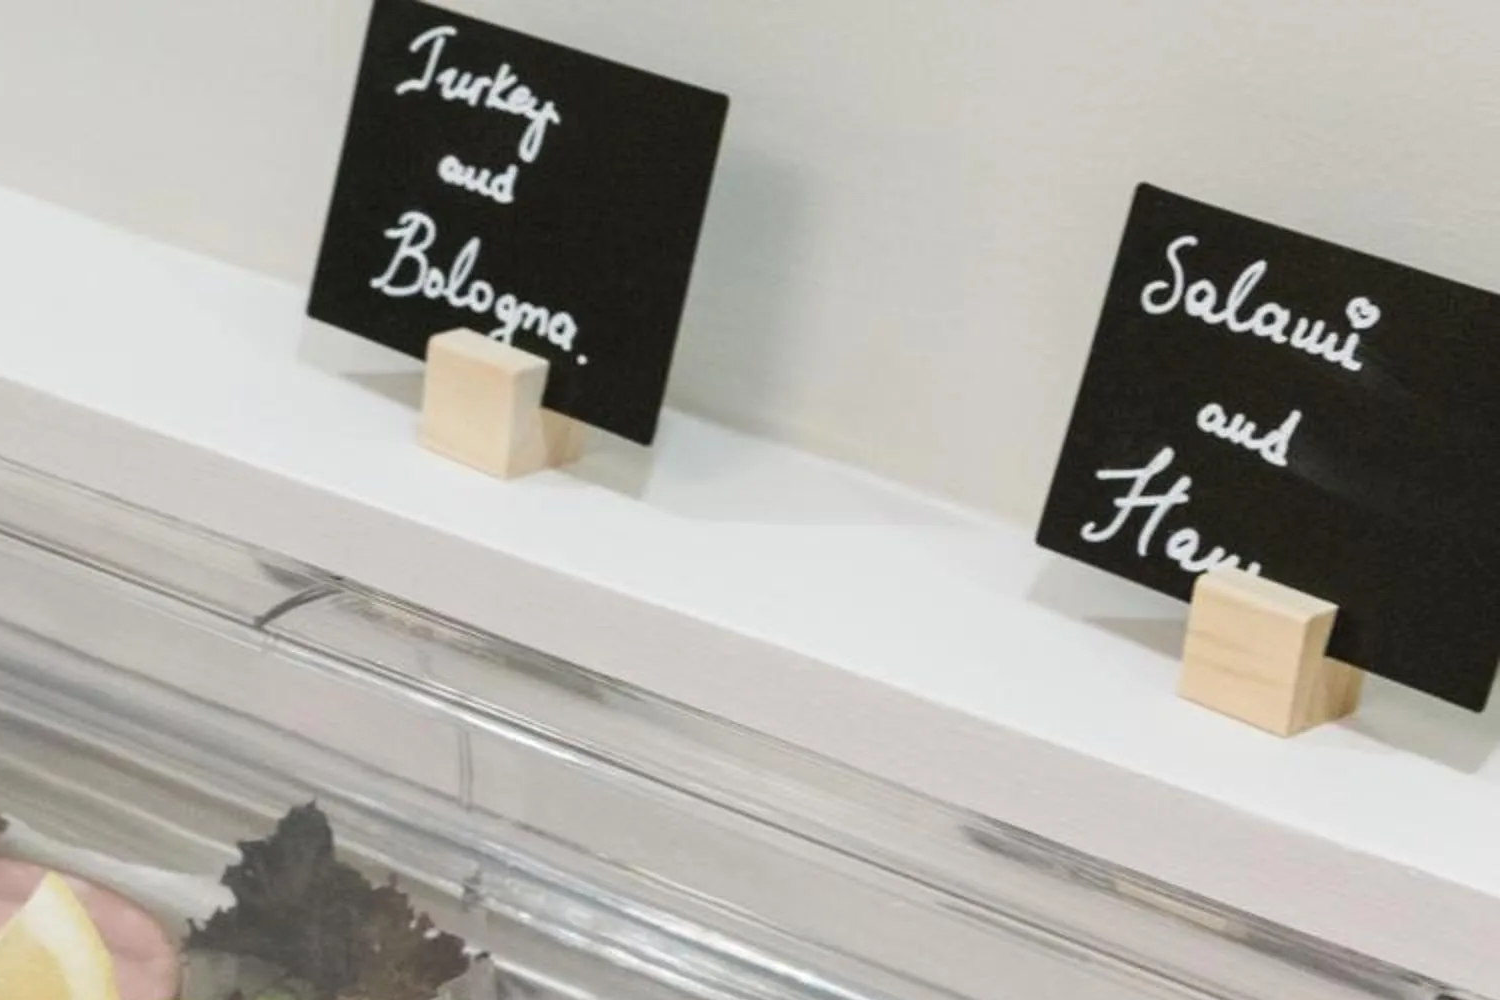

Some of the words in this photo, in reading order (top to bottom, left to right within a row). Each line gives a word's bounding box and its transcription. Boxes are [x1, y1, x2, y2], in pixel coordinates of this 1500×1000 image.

[394, 25, 561, 163] Turkey
[436, 154, 519, 204] and
[1140, 235, 1381, 372] Salami
[1196, 402, 1302, 467] and
